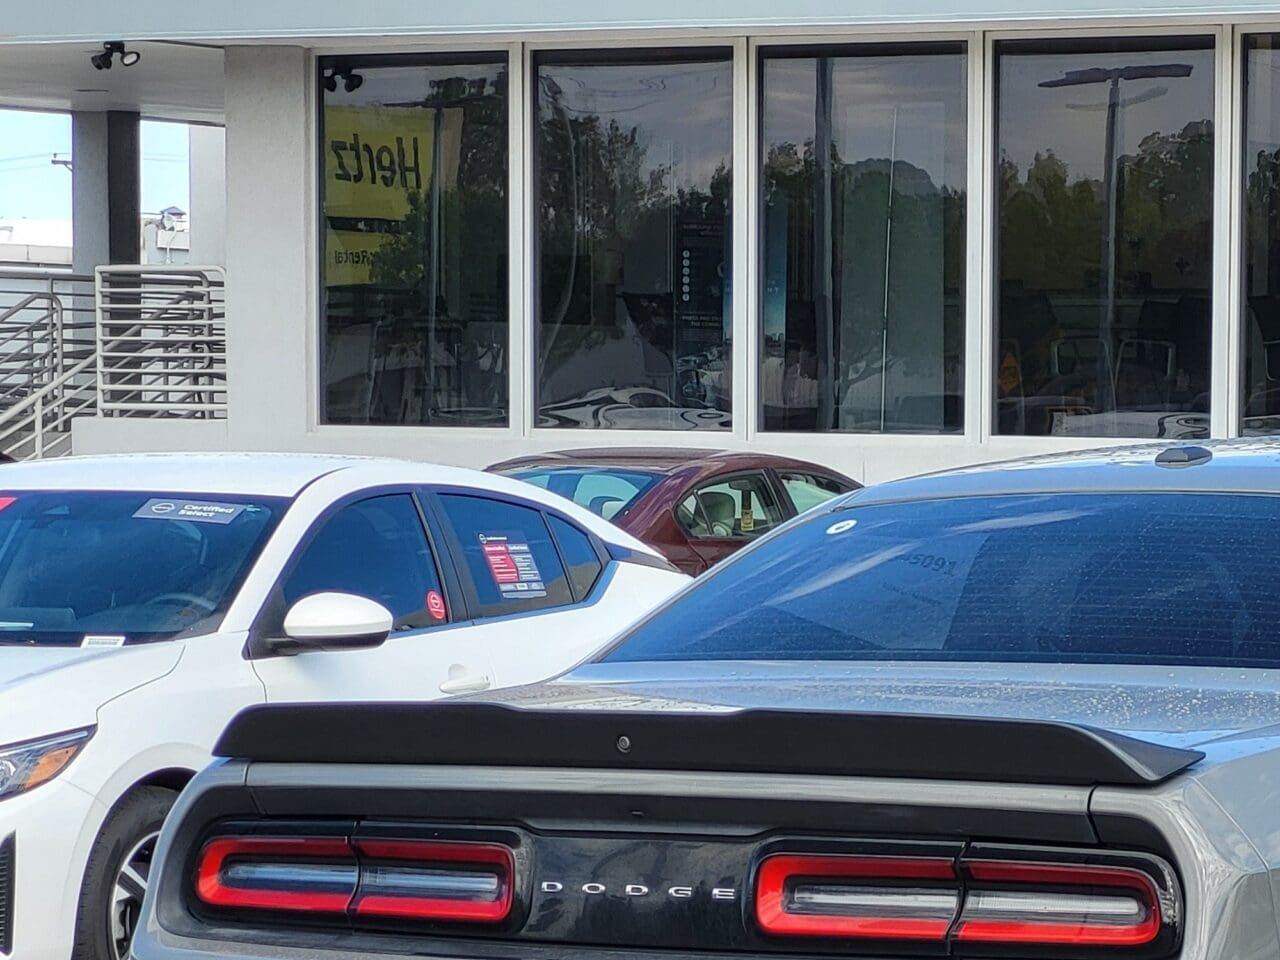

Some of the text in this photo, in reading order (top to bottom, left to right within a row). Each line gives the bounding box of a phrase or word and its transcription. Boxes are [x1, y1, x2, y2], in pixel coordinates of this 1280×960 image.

[178, 509, 215, 517] Select
[183, 504, 234, 514] Certified
[541, 881, 735, 899] DODGE
